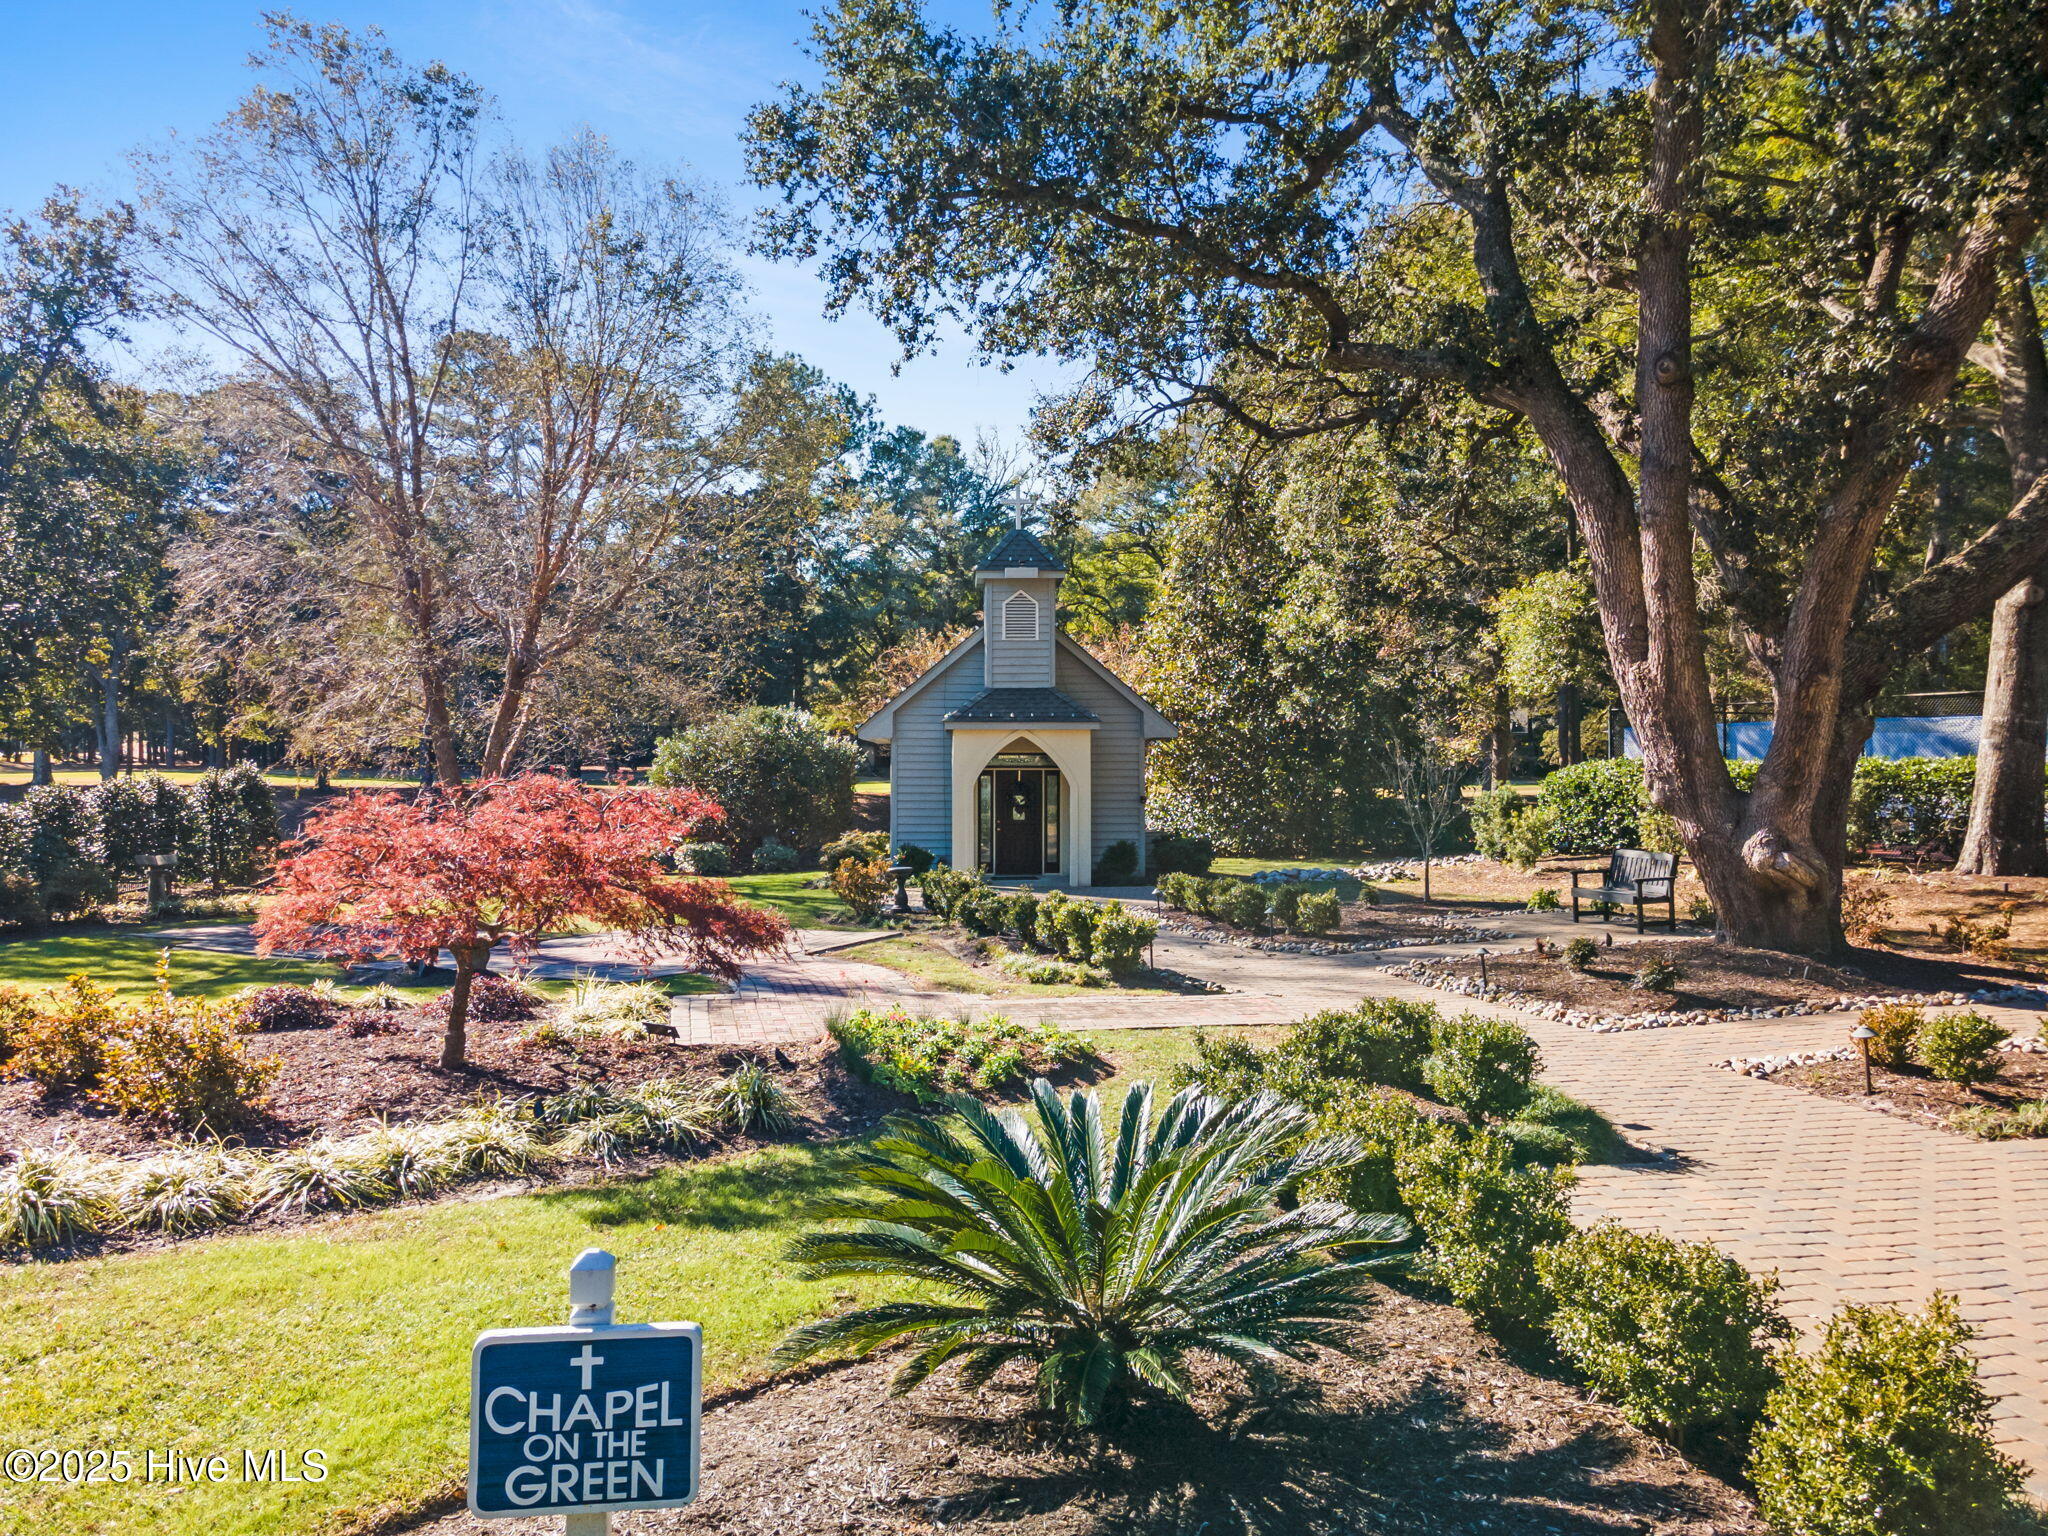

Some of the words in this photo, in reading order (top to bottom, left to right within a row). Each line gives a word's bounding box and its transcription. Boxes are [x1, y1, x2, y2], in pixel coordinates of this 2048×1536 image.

[485, 1381, 683, 1434] CHAPEL
[523, 1432, 579, 1462] ON
[592, 1430, 646, 1458] THE
[505, 1458, 664, 1506] GREEN
